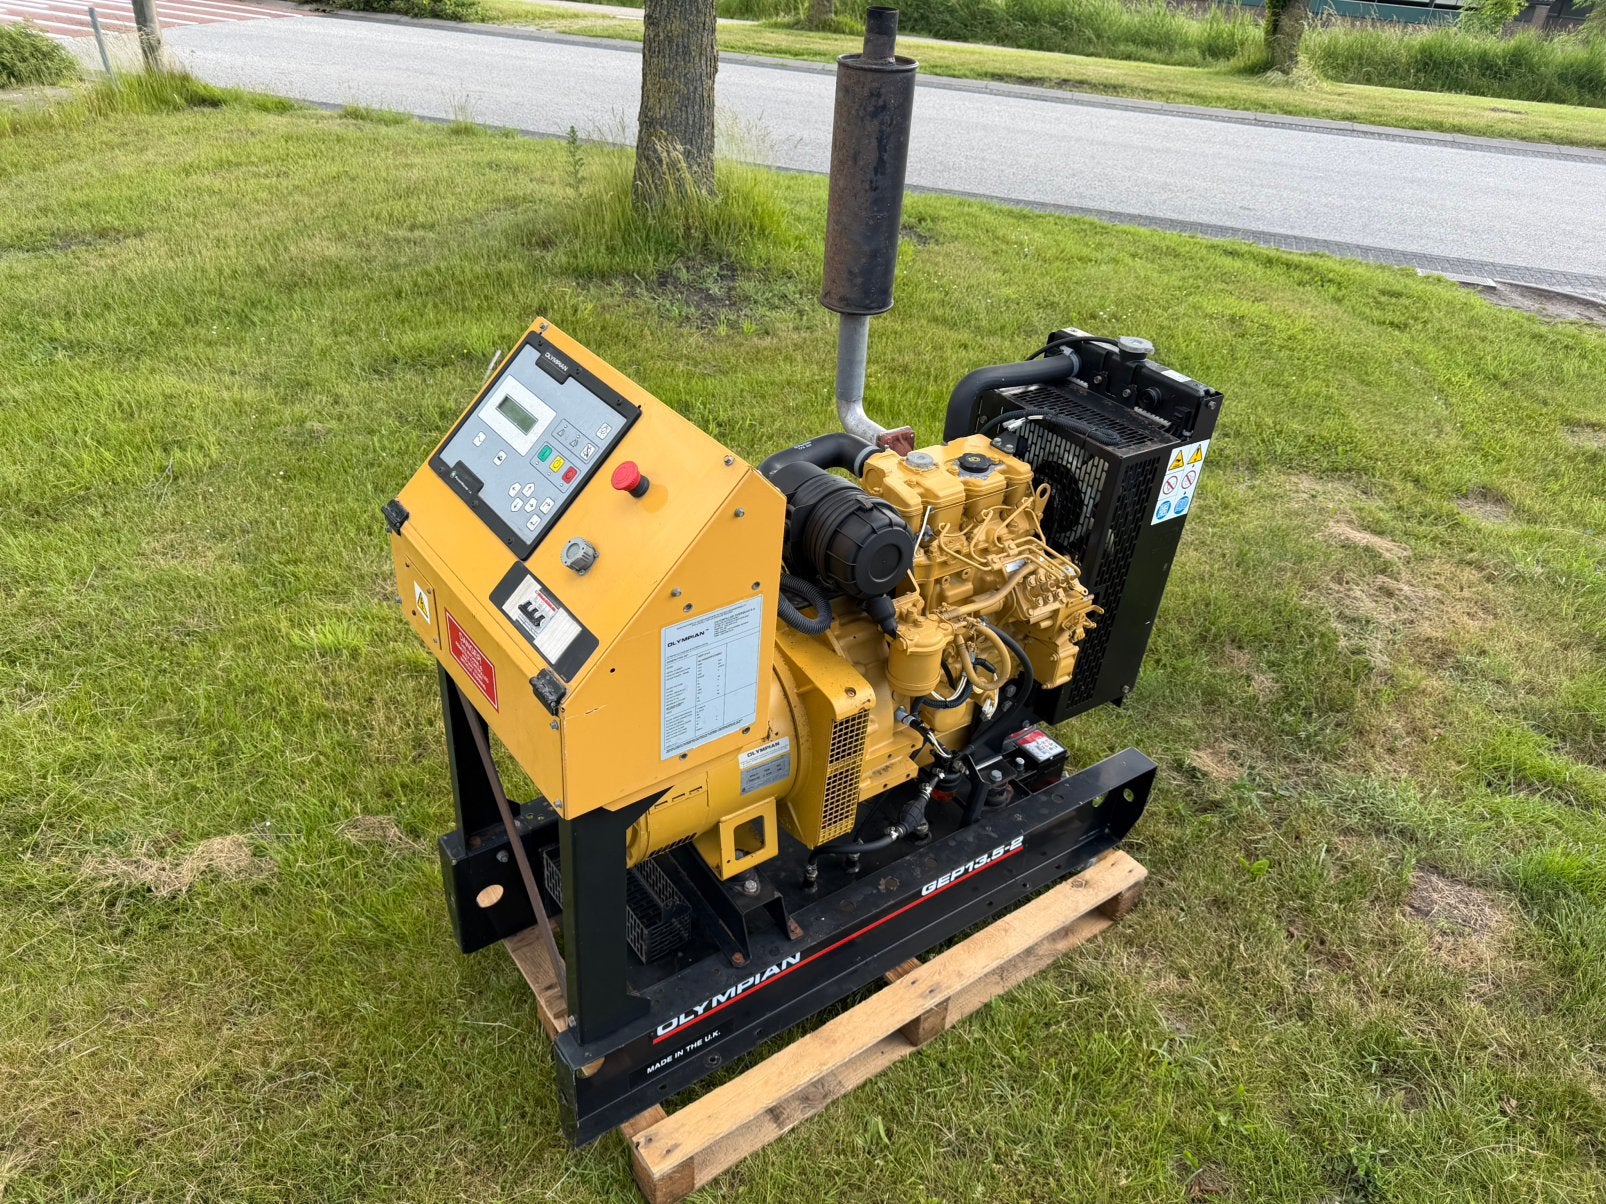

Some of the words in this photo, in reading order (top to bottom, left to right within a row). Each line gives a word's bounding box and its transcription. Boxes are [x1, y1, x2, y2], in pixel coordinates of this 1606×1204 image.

[544, 351, 569, 372] OLYMPIAN
[667, 631, 705, 648] OLYMPIAN
[746, 741, 780, 758] OLYMPIAN
[921, 835, 1024, 896] GEP13.5-2
[656, 951, 801, 1037] OLYMPIAN
[646, 1054, 673, 1074] MADE
[674, 1049, 684, 1058] IN
[685, 1038, 703, 1053] THE
[704, 1030, 721, 1043] U.K.
